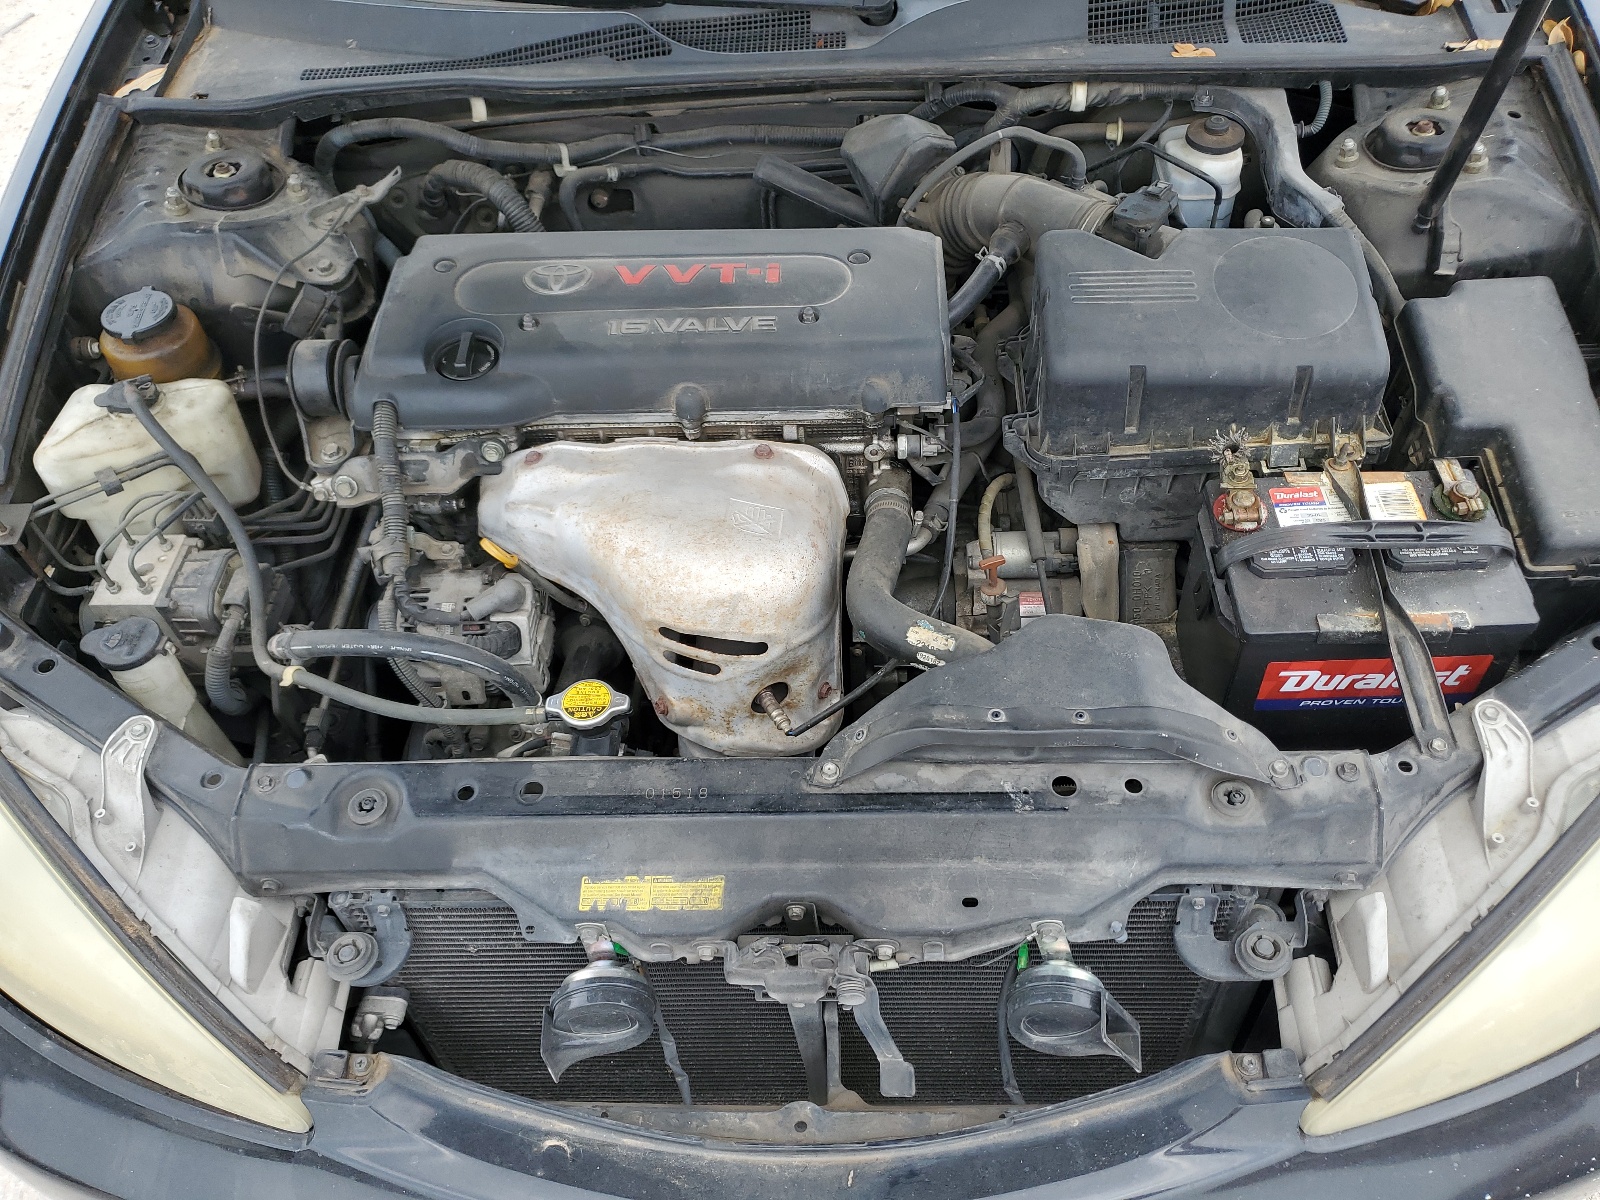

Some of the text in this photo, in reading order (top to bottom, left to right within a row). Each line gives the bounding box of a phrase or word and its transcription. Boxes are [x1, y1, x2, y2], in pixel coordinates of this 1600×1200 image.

[614, 263, 781, 285] VVT-i
[654, 316, 778, 334] VALVE
[1273, 491, 1319, 500] Duralast
[1278, 664, 1472, 693] Duralst
[1298, 697, 1404, 707] PROVEN TOU
[645, 787, 708, 799] 01518
